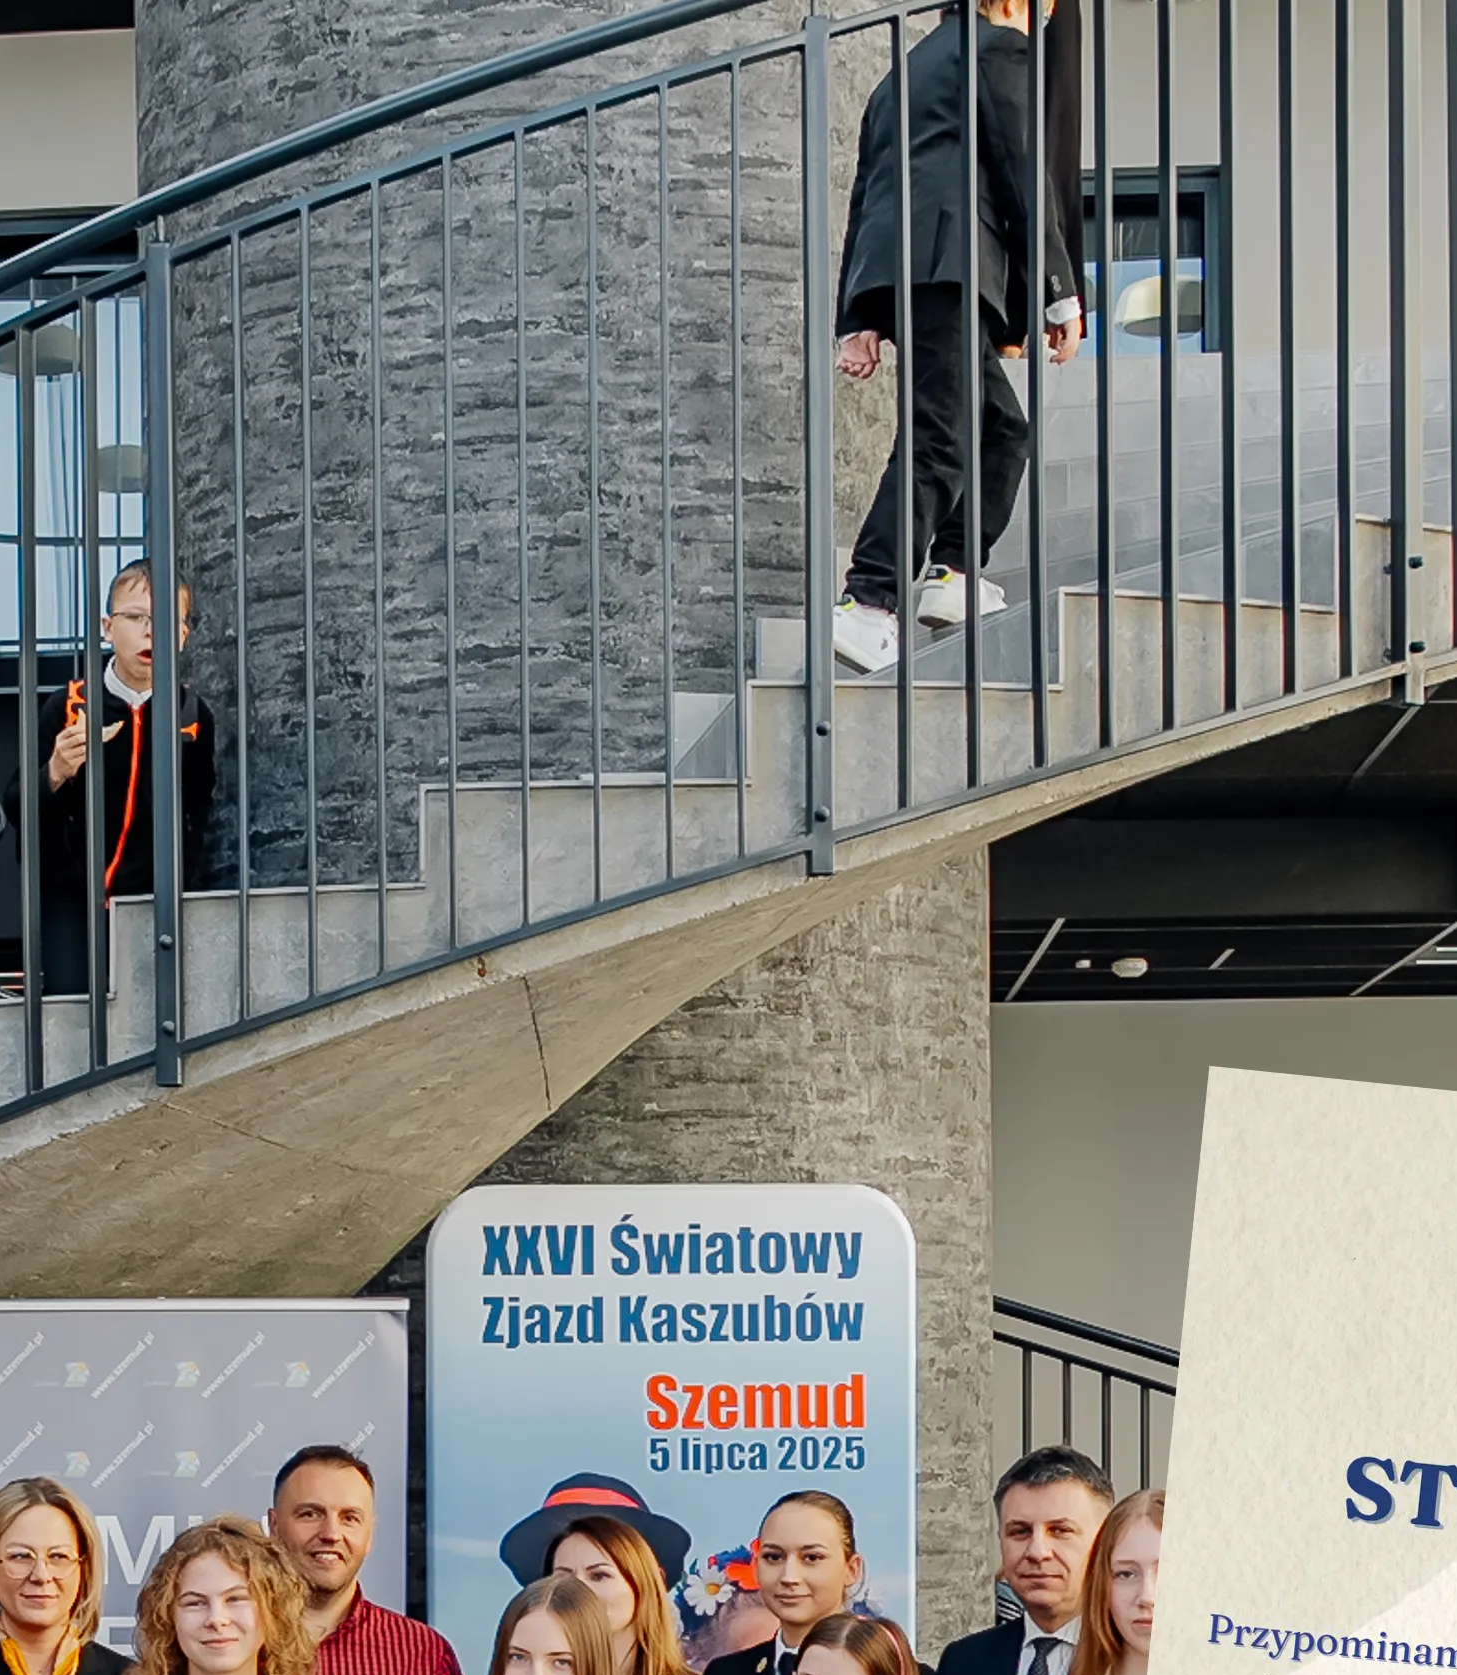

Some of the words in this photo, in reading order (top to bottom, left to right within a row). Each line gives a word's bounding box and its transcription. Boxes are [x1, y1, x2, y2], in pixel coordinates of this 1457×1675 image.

[482, 1225, 595, 1276] XXVI
[610, 1214, 863, 1279] Światowy
[482, 1296, 604, 1349] Zjazd
[619, 1292, 865, 1343] Kaszubów
[646, 1374, 866, 1431] Szemud
[649, 1438, 670, 1472] 5
[681, 1437, 767, 1474] lipca
[778, 1436, 866, 1471] 2025
